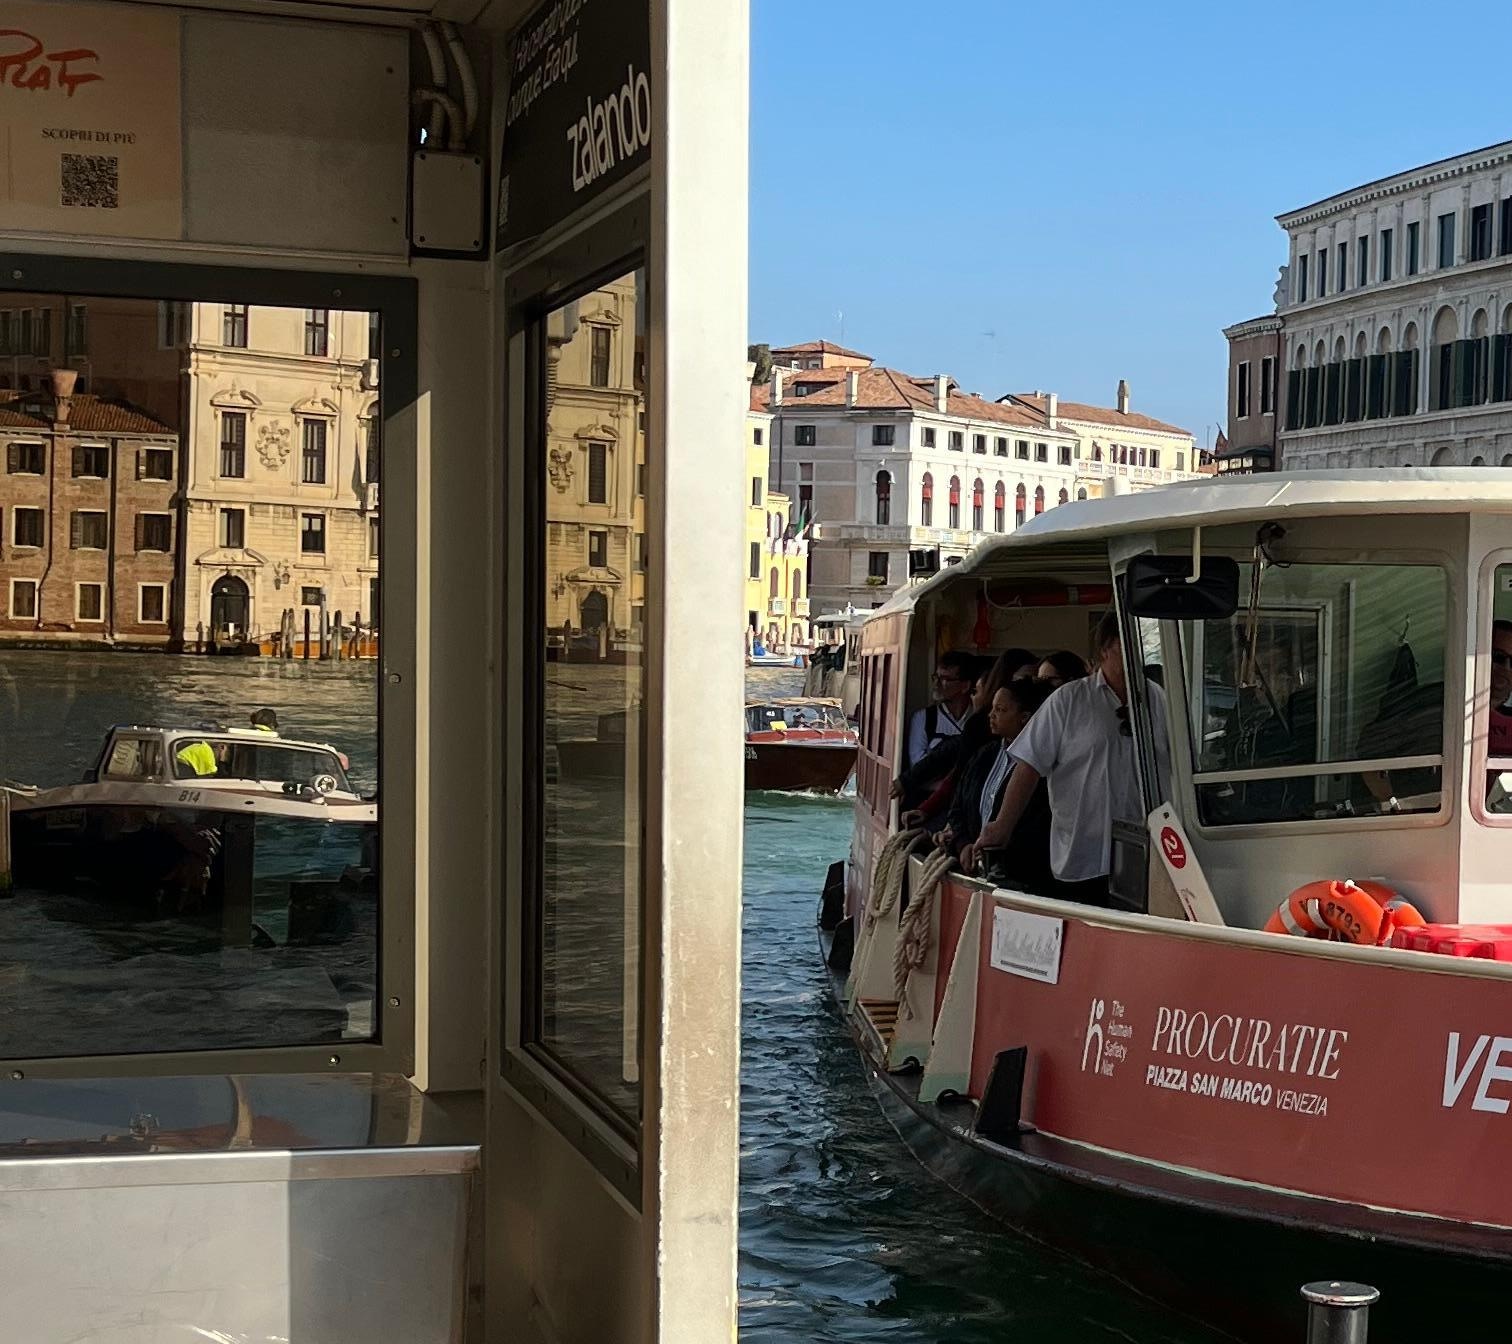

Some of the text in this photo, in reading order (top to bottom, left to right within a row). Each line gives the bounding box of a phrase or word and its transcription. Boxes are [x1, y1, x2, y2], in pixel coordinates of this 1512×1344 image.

[41, 127, 92, 142] SCOPRI
[95, 131, 112, 144] DI
[567, 64, 650, 192] zalando
[178, 789, 201, 803] B14
[1111, 1000, 1125, 1018] The
[1107, 1019, 1133, 1039] Human
[1103, 1040, 1129, 1063] Safety
[1151, 1006, 1349, 1080] PROCURATIE
[1101, 1059, 1114, 1077] Net
[1145, 1064, 1329, 1116] PIAZZA SAN MARCO VENEZIA
